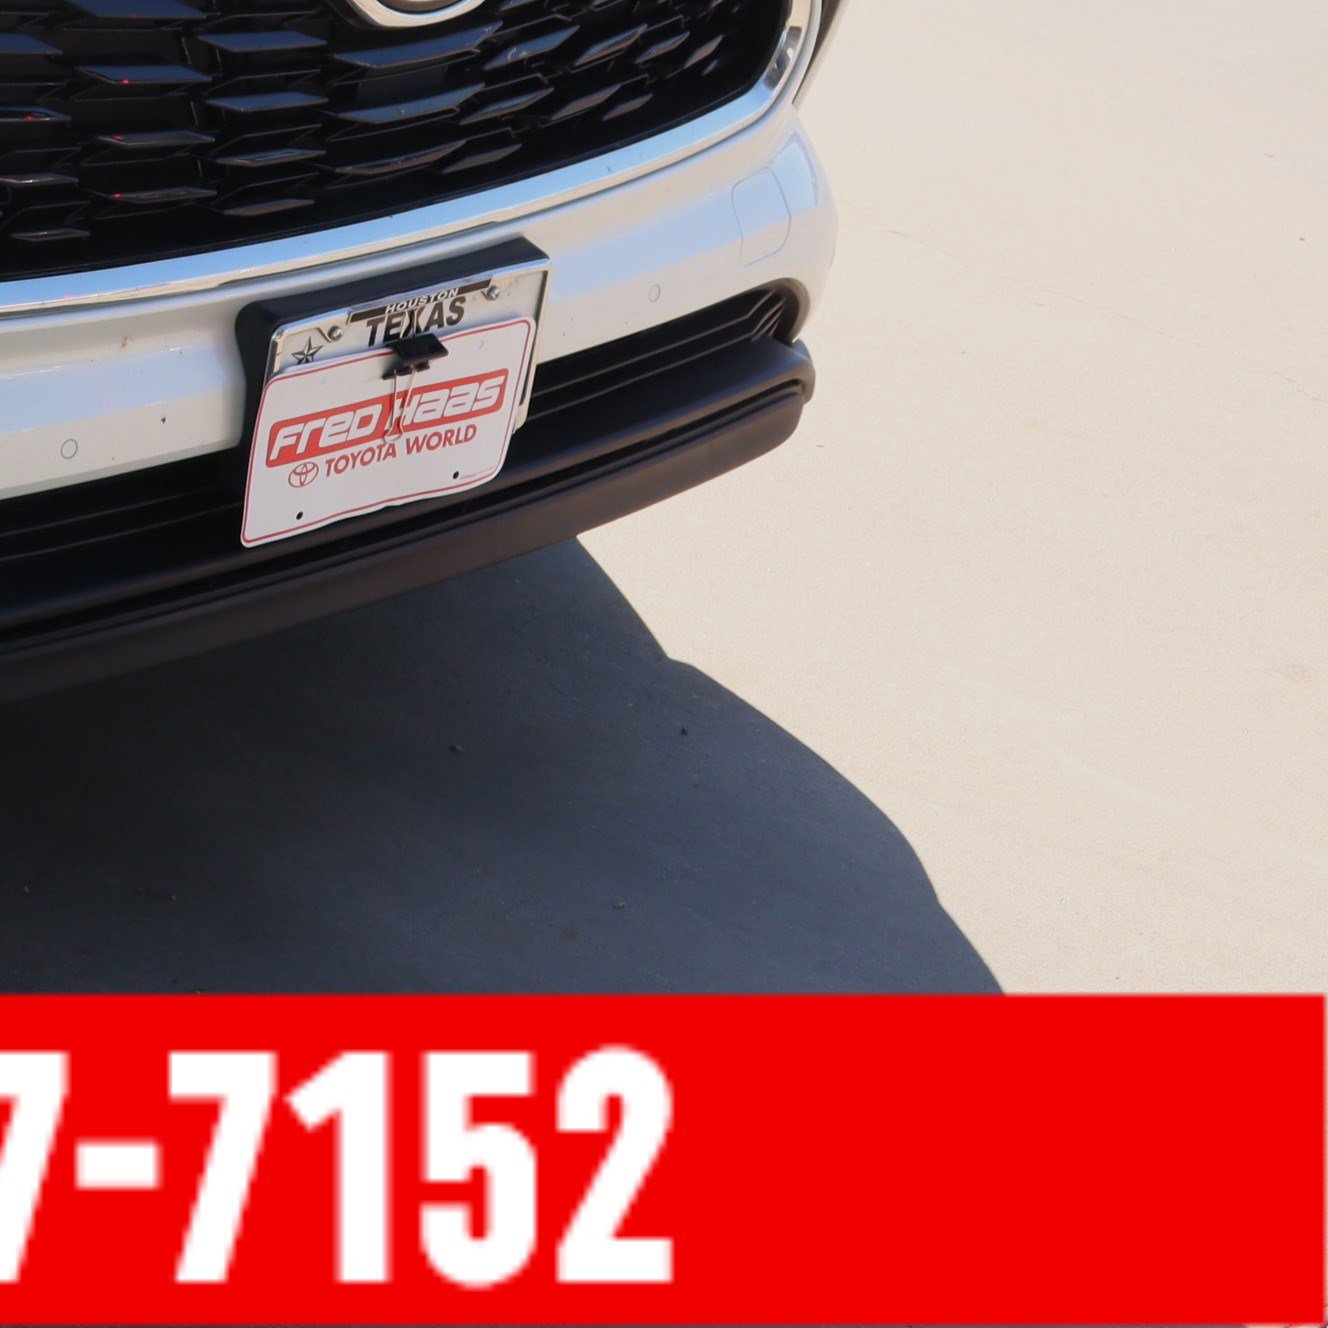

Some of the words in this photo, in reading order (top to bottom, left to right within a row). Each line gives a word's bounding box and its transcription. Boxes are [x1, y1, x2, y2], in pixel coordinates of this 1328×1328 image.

[366, 295, 466, 347] TEXAS
[385, 287, 459, 314] HOUSTON
[325, 441, 397, 477] TOYOTA
[405, 424, 478, 455] WORLD
